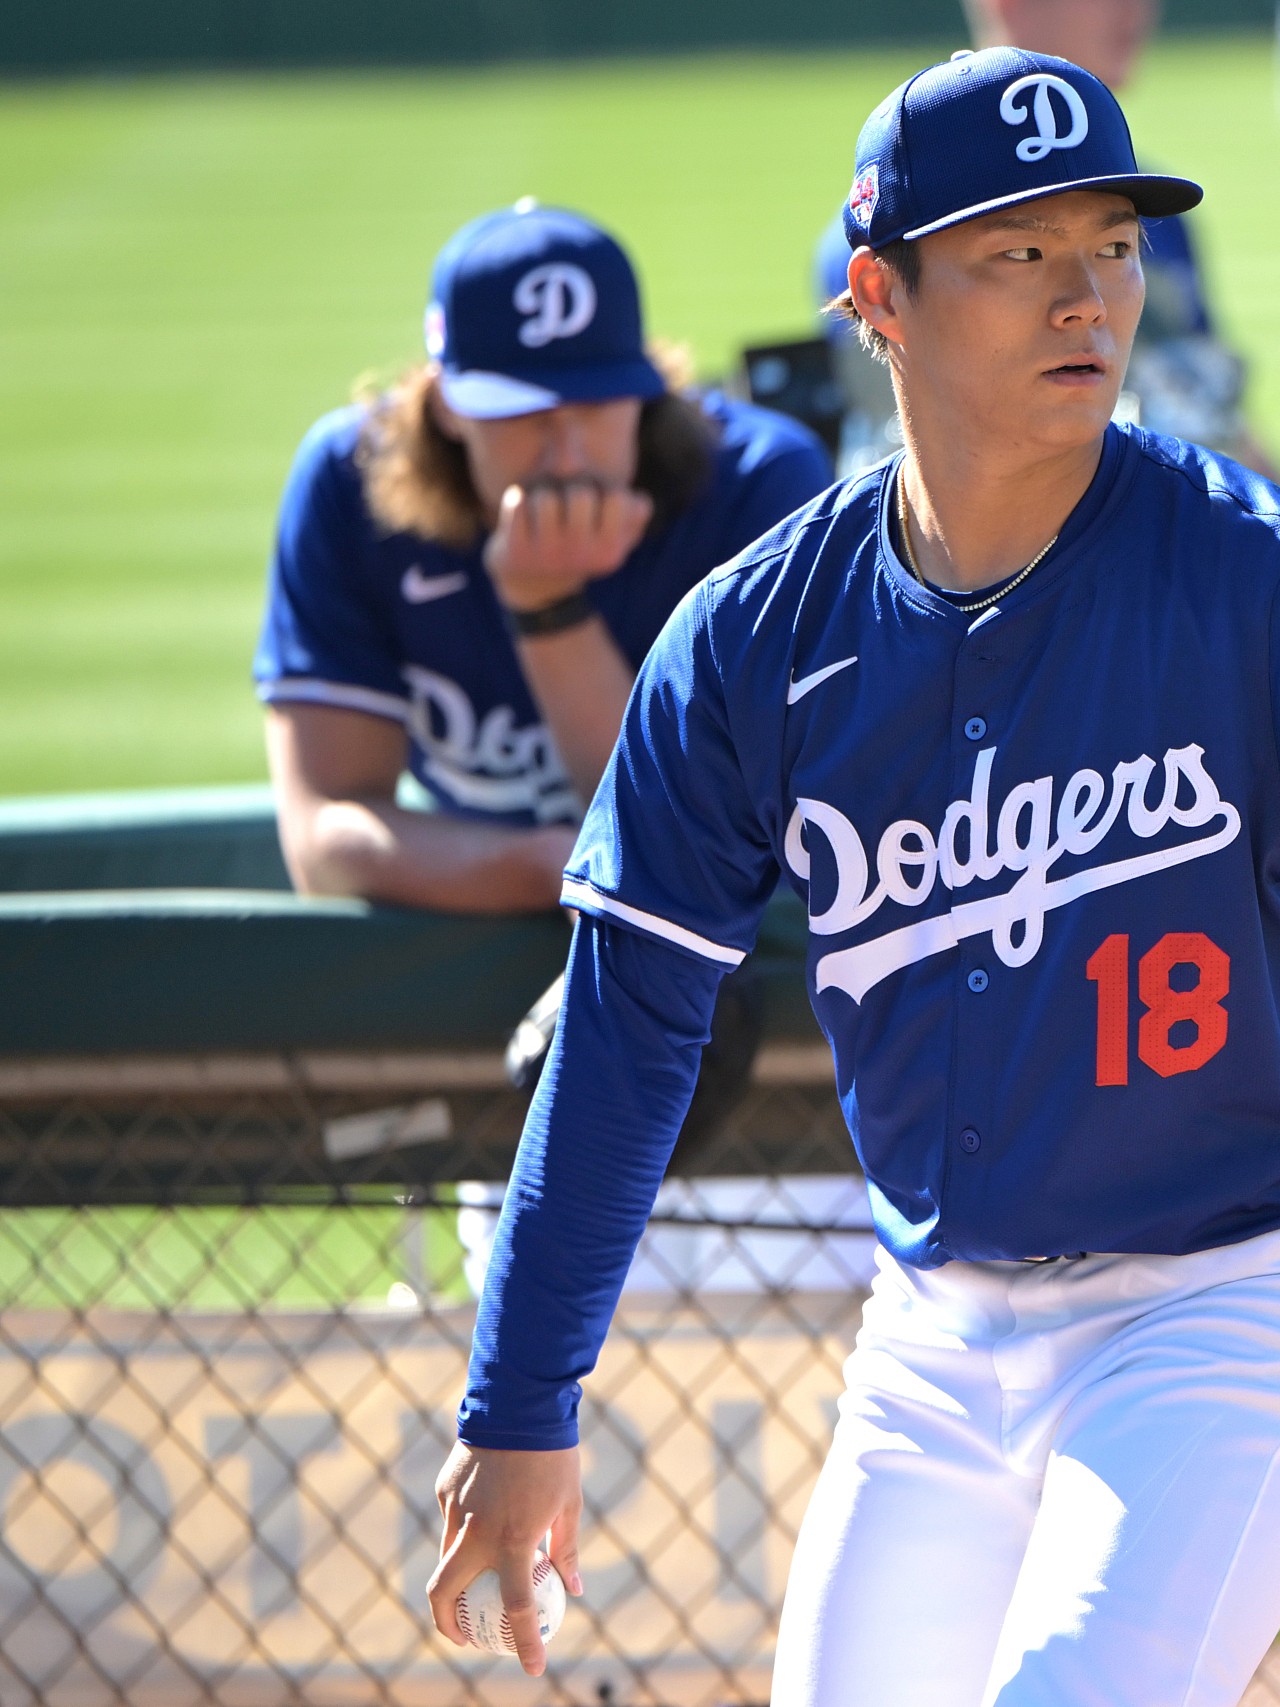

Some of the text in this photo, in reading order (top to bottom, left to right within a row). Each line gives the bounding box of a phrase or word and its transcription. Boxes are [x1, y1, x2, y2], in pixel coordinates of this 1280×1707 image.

[1000, 73, 1089, 163] D
[512, 261, 598, 349] D
[784, 743, 1241, 968] Dodgers
[1086, 932, 1231, 1087] 18
